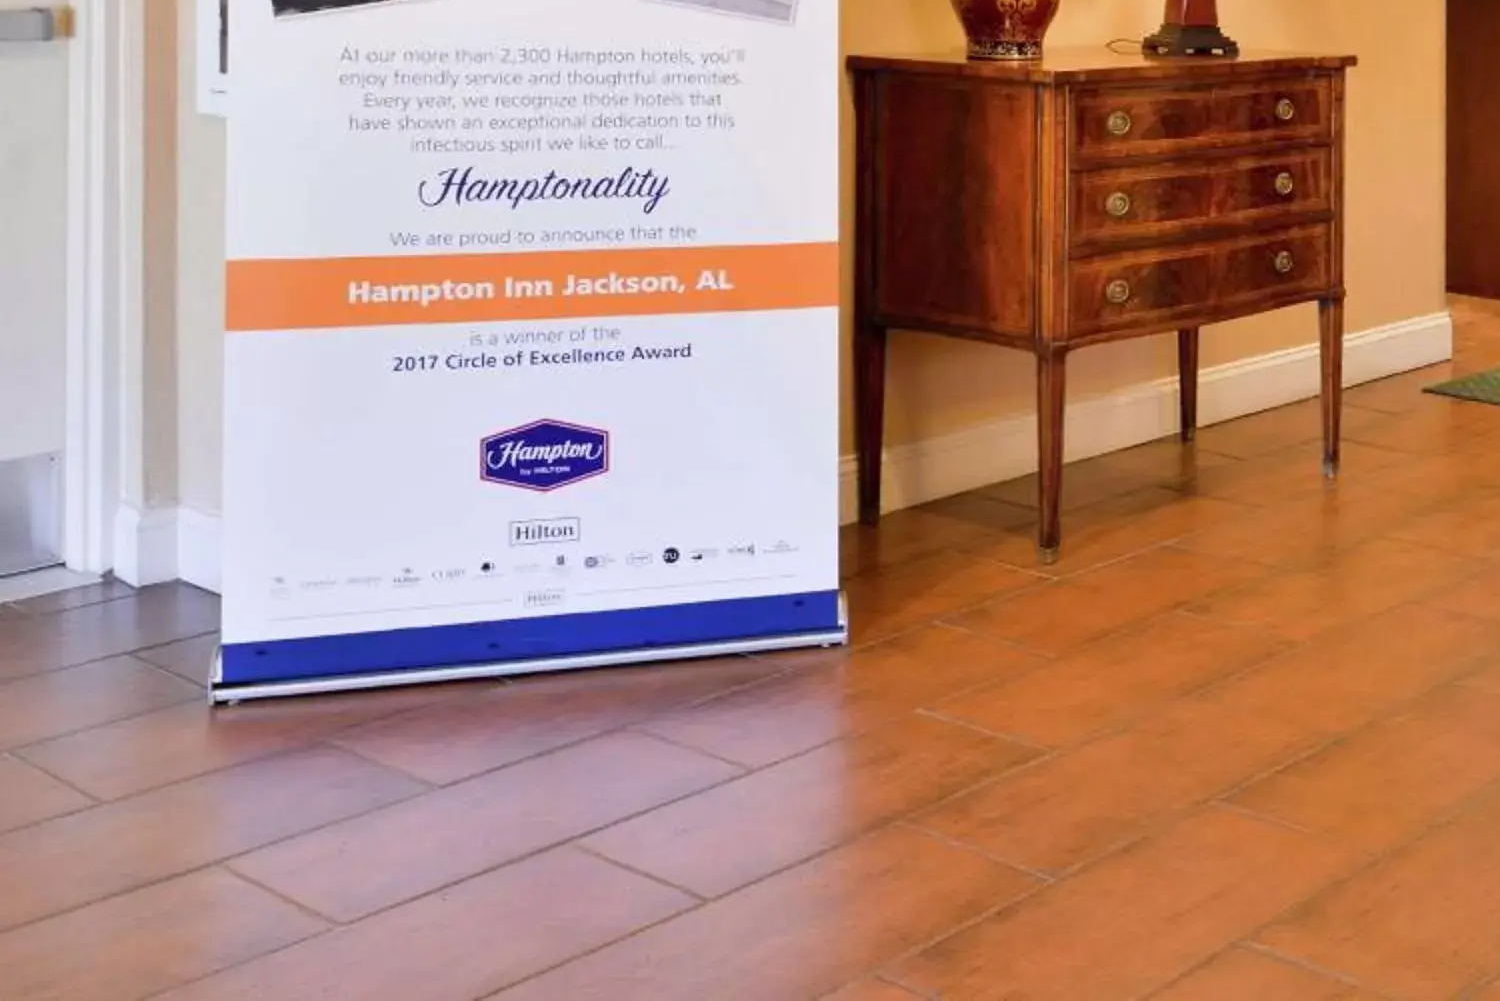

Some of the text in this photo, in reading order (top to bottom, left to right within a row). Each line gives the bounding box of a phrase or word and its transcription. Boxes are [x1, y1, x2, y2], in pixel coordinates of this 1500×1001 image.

[340, 47, 359, 63] At
[365, 50, 396, 64] our
[402, 49, 450, 64] more
[454, 48, 494, 63] than
[499, 49, 551, 65] 2,300
[557, 48, 636, 66] Hampton
[641, 48, 696, 65] hotels,
[338, 71, 388, 89] enjoy
[393, 69, 460, 88] friendly
[464, 71, 524, 86] service
[527, 70, 561, 86] and
[567, 69, 655, 88] thoughtful
[363, 91, 722, 111] Every year, we recognize those hotels that
[348, 112, 736, 133] have shown an exceptional dedication to this
[411, 137, 495, 154] infectious
[501, 137, 542, 155] spirit
[549, 137, 574, 150] we
[578, 134, 609, 151] like
[613, 136, 631, 150] to
[418, 165, 671, 215] Hamptonality
[389, 223, 698, 250] We are proud to announce that the
[347, 268, 735, 308] Hampton Inn Jackson, AL
[468, 324, 622, 348] is a winner of the
[391, 342, 693, 373] 2017 Circle of Excellence Award
[486, 439, 603, 471] Hampton
[514, 523, 575, 542] Hilton
